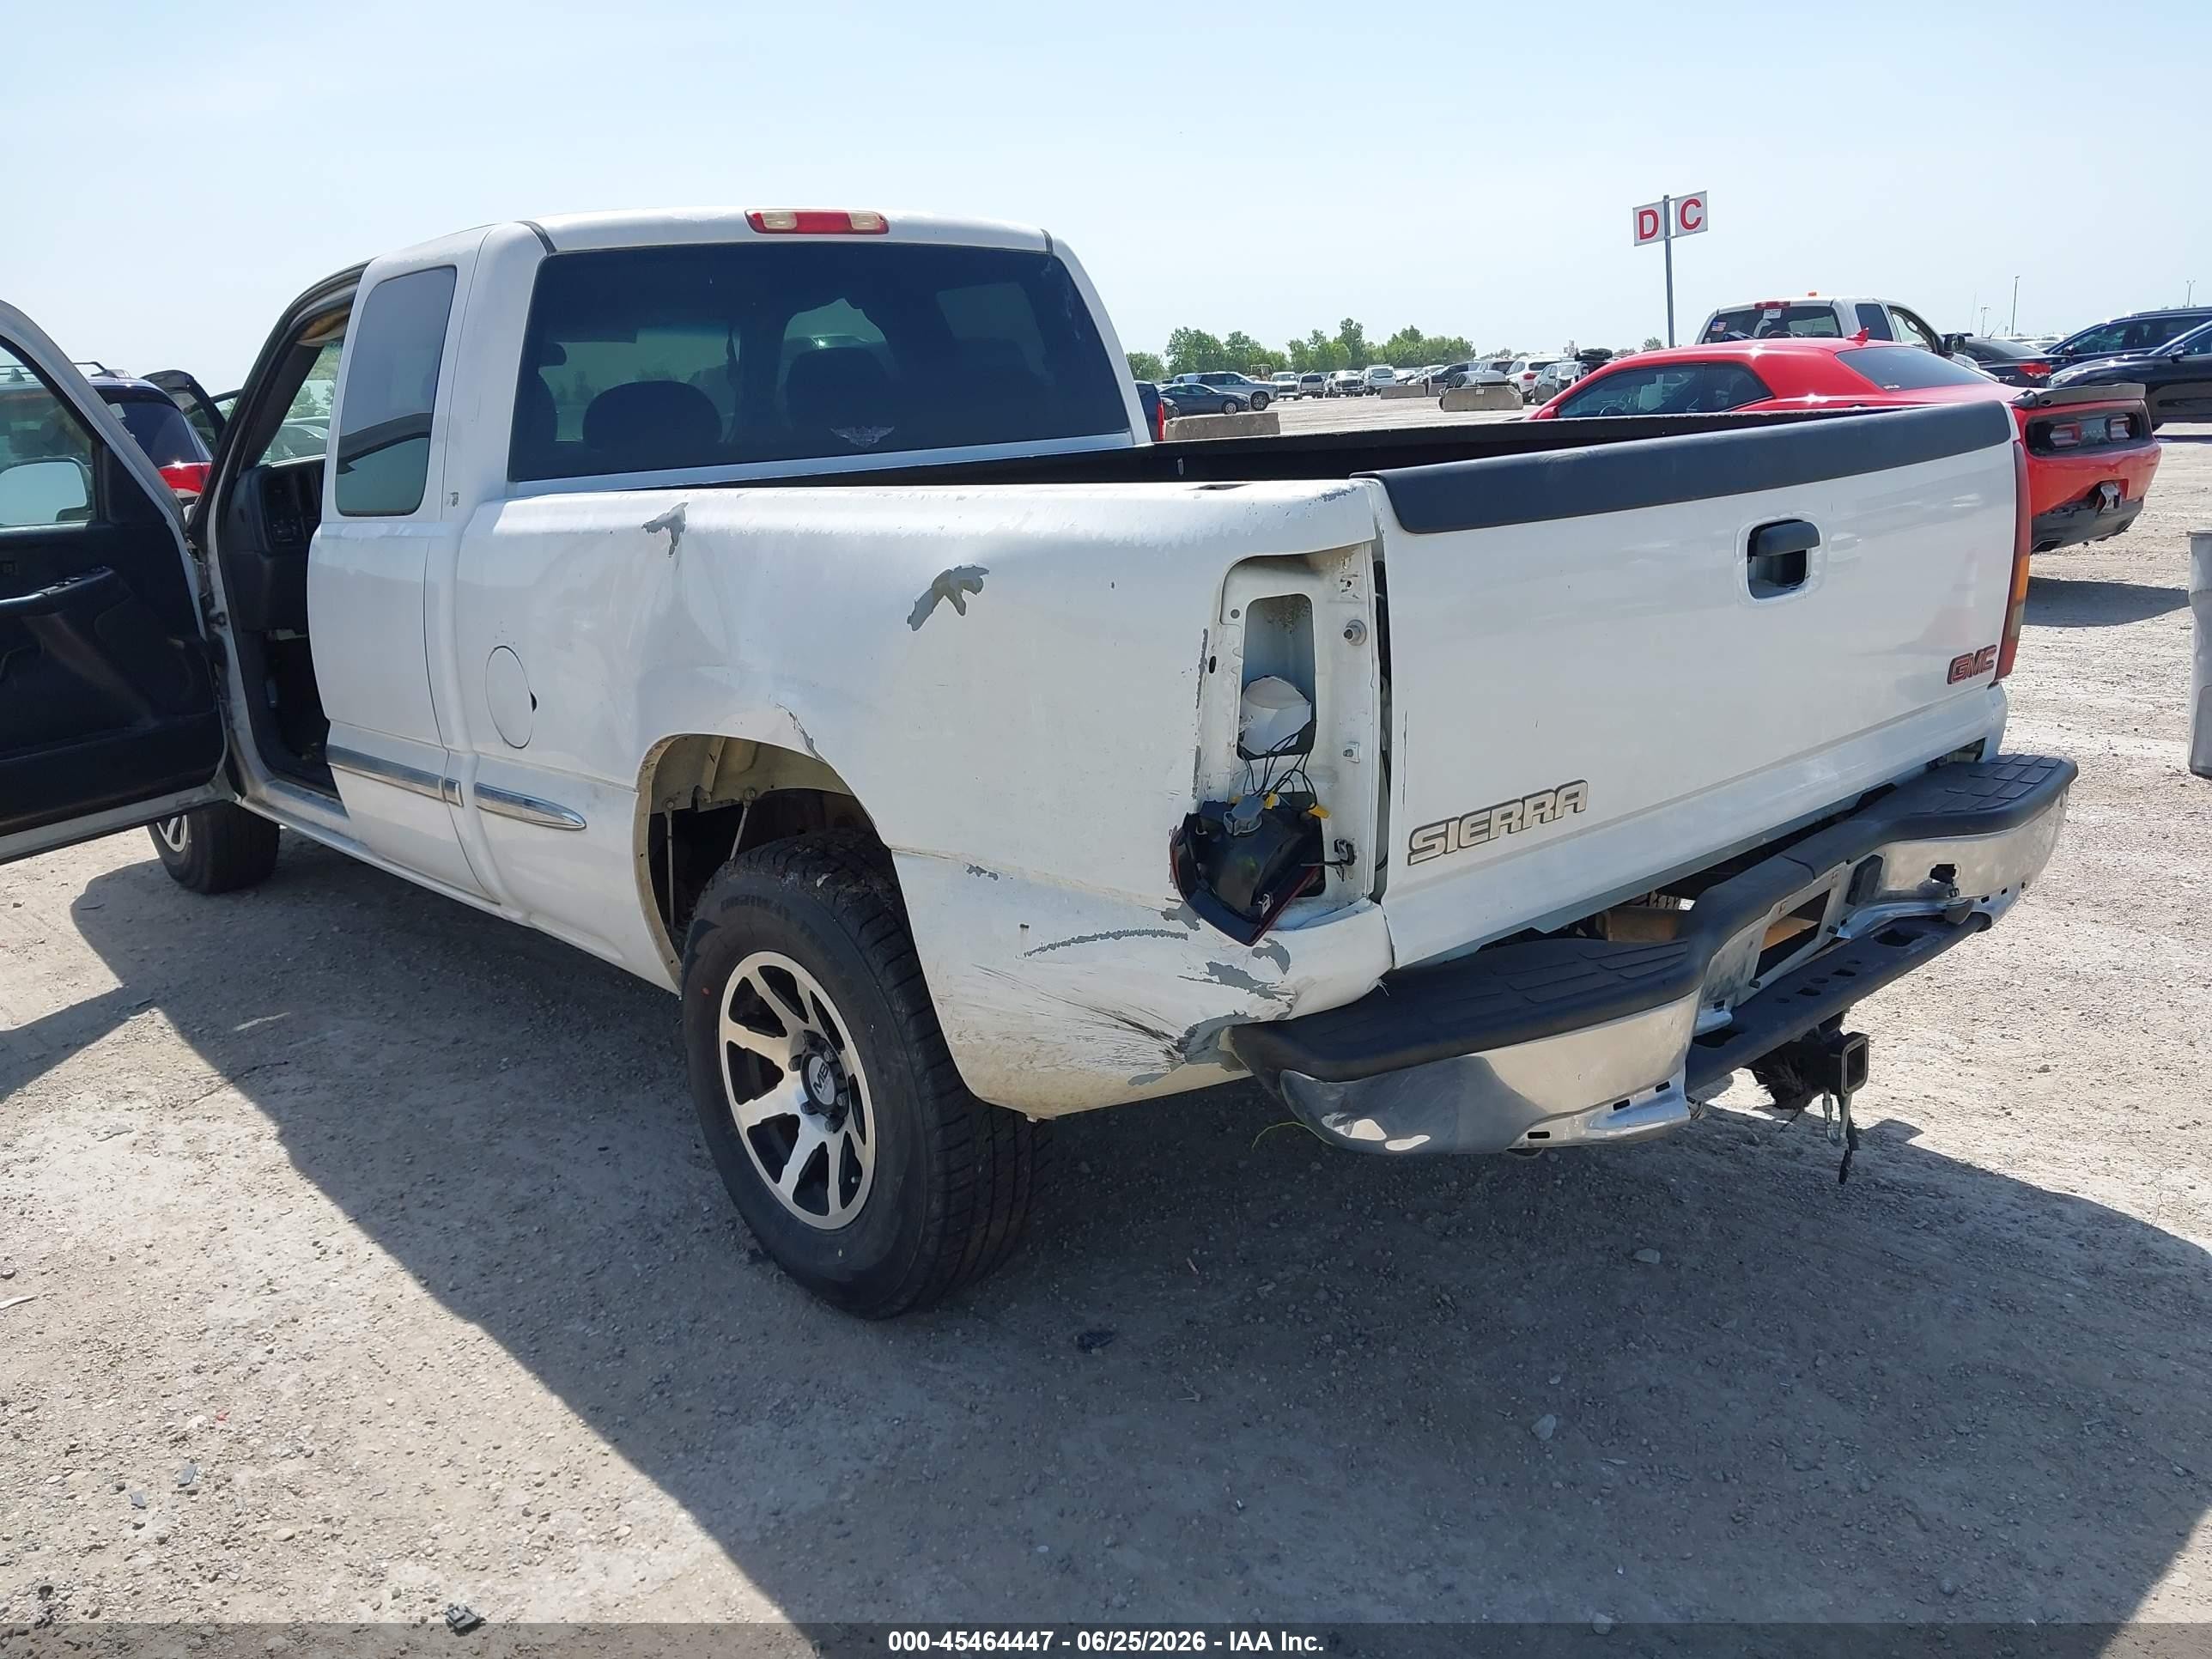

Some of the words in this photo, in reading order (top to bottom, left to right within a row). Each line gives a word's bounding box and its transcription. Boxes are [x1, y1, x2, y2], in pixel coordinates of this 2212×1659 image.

[1638, 209, 1659, 240] D
[1680, 198, 1702, 230] C
[1947, 644, 1997, 684] GMC
[1407, 779, 1589, 866] SIERRA
[813, 1061, 830, 1095] MB
